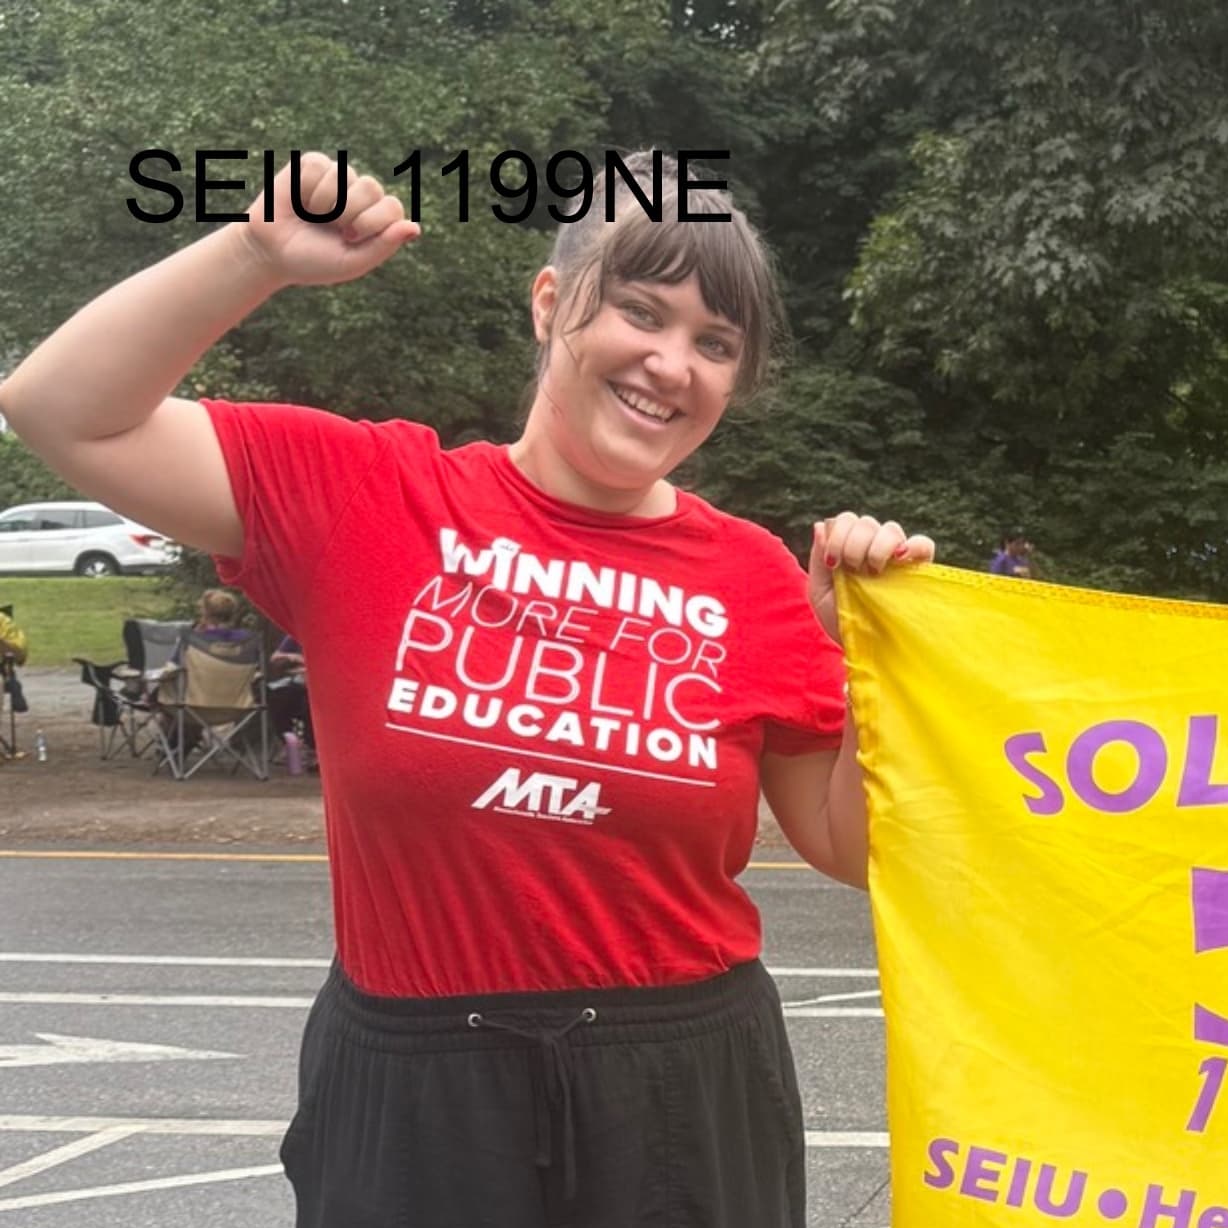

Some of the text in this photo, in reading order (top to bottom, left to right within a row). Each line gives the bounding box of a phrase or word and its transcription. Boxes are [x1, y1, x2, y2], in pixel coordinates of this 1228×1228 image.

[413, 574, 727, 677] MORE FOR
[439, 526, 730, 639] WINNING
[394, 608, 723, 731] PUBLIC
[386, 677, 718, 770] EDUCATION
[470, 766, 613, 820] MTA
[923, 1138, 1086, 1219] SEIU
